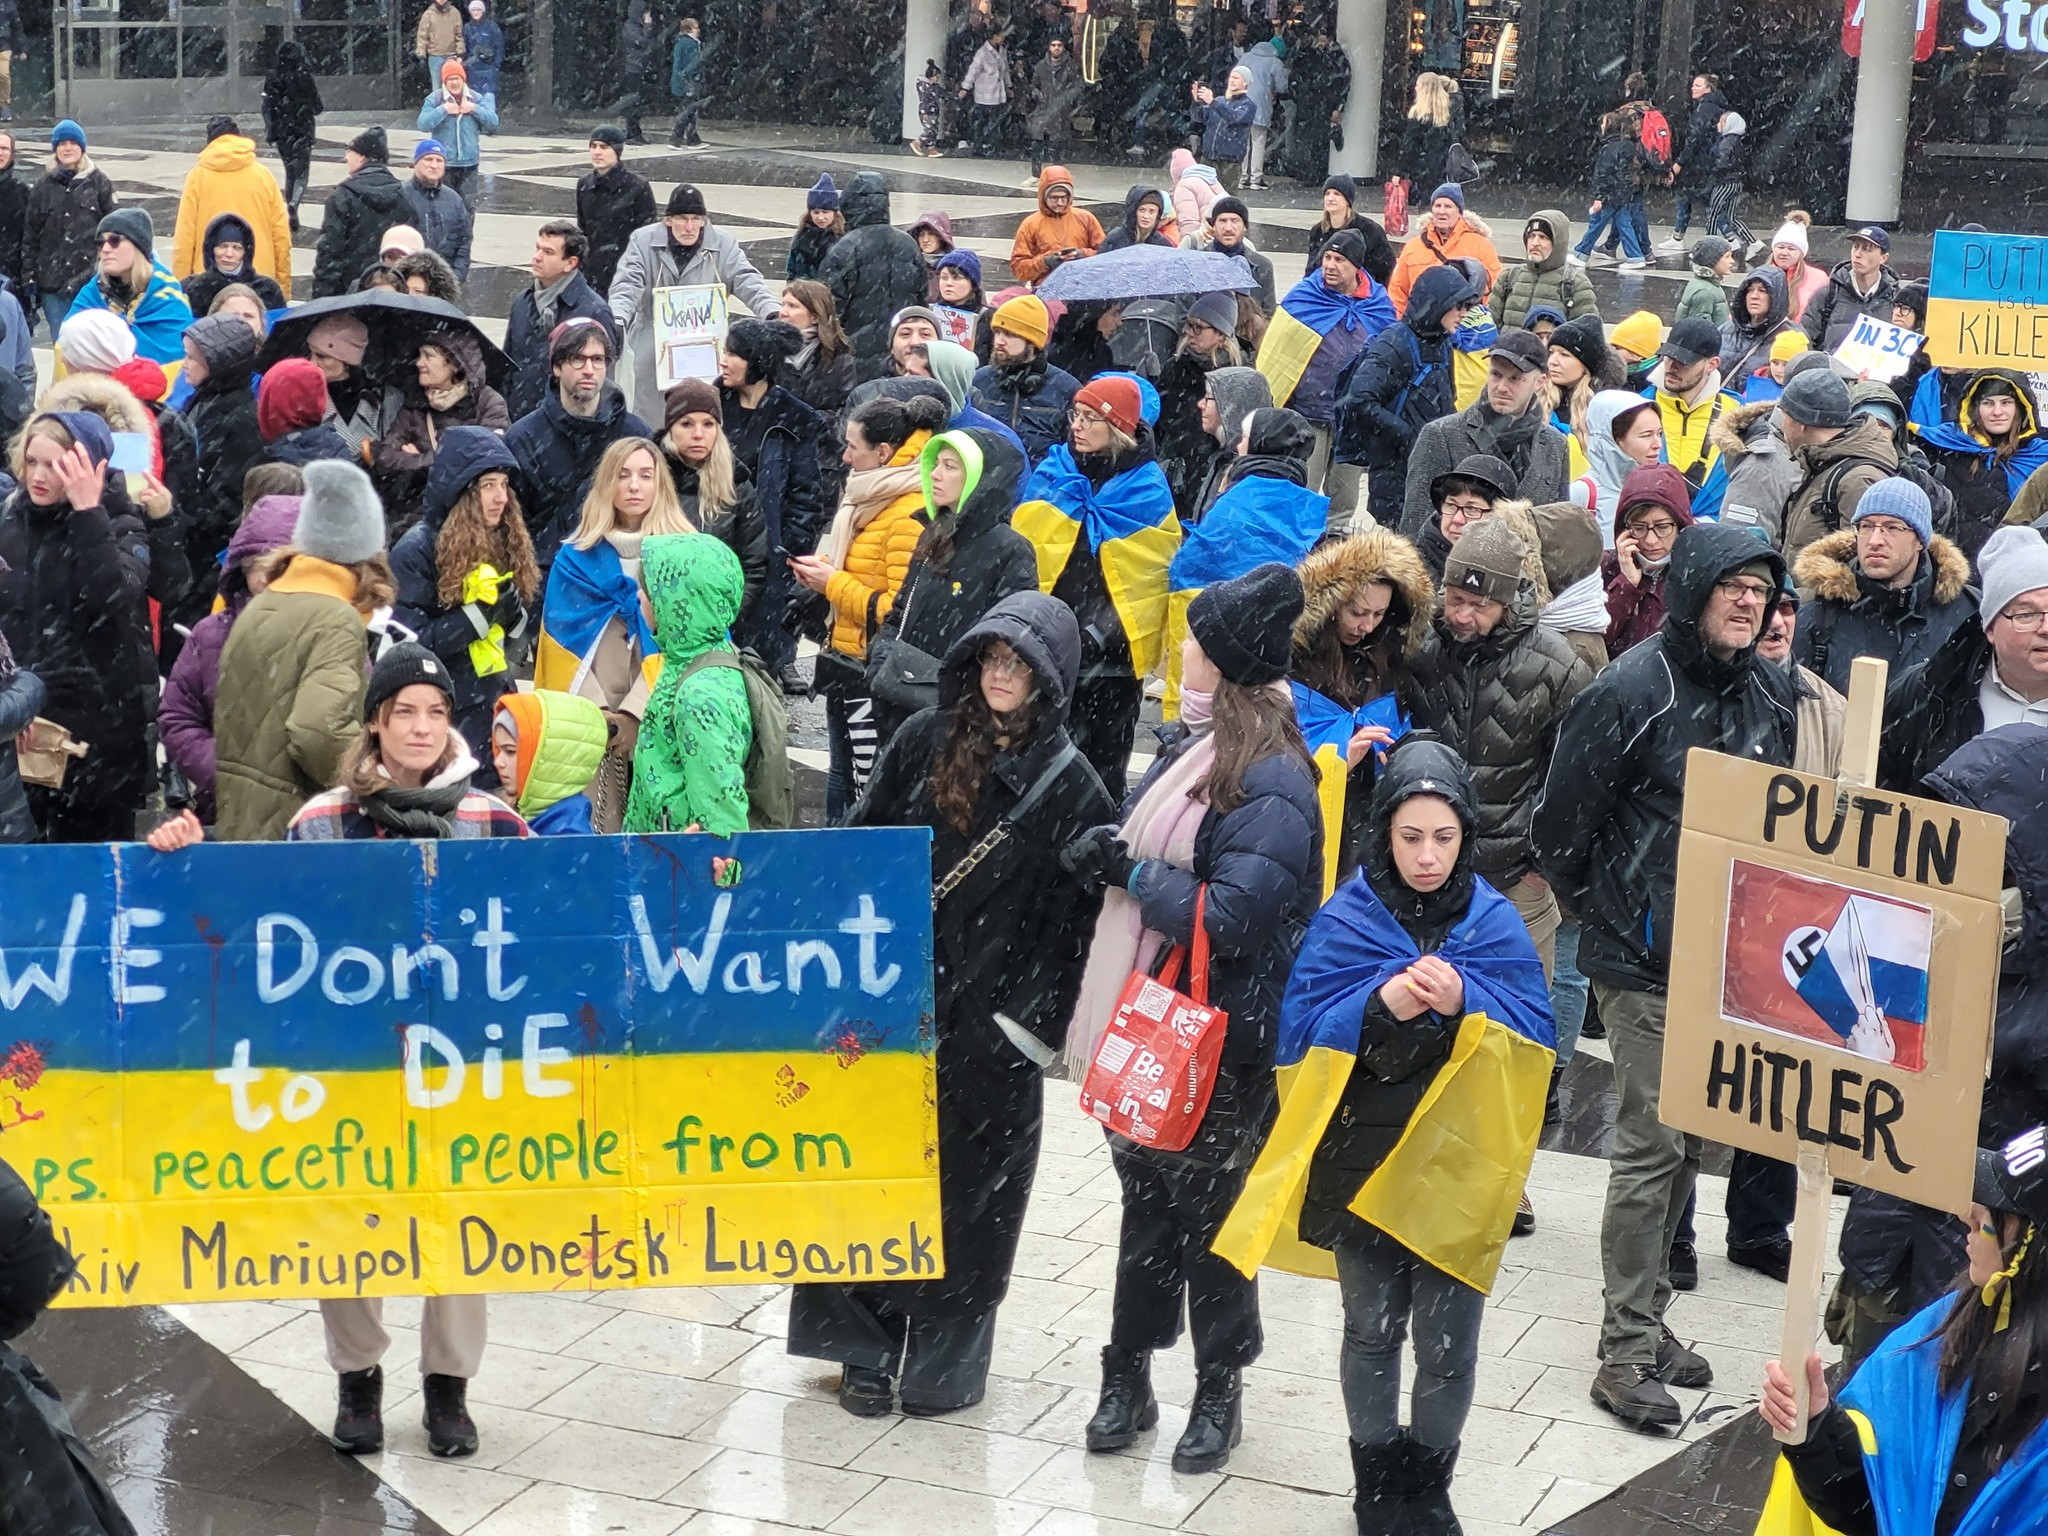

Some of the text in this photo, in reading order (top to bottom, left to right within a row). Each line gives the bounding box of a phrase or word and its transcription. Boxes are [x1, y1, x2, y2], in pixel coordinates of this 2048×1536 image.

[1998, 293, 2038, 310] is a
[0, 892, 901, 1010] WE Don't Want
[214, 1038, 327, 1132] to
[1187, 1048, 1198, 1098] lululemo
[154, 1118, 417, 1196] peaceful
[451, 1118, 625, 1184] people
[662, 1115, 853, 1175] from
[62, 1206, 936, 1295] kiv Mariupol Donetsk Lugansk
